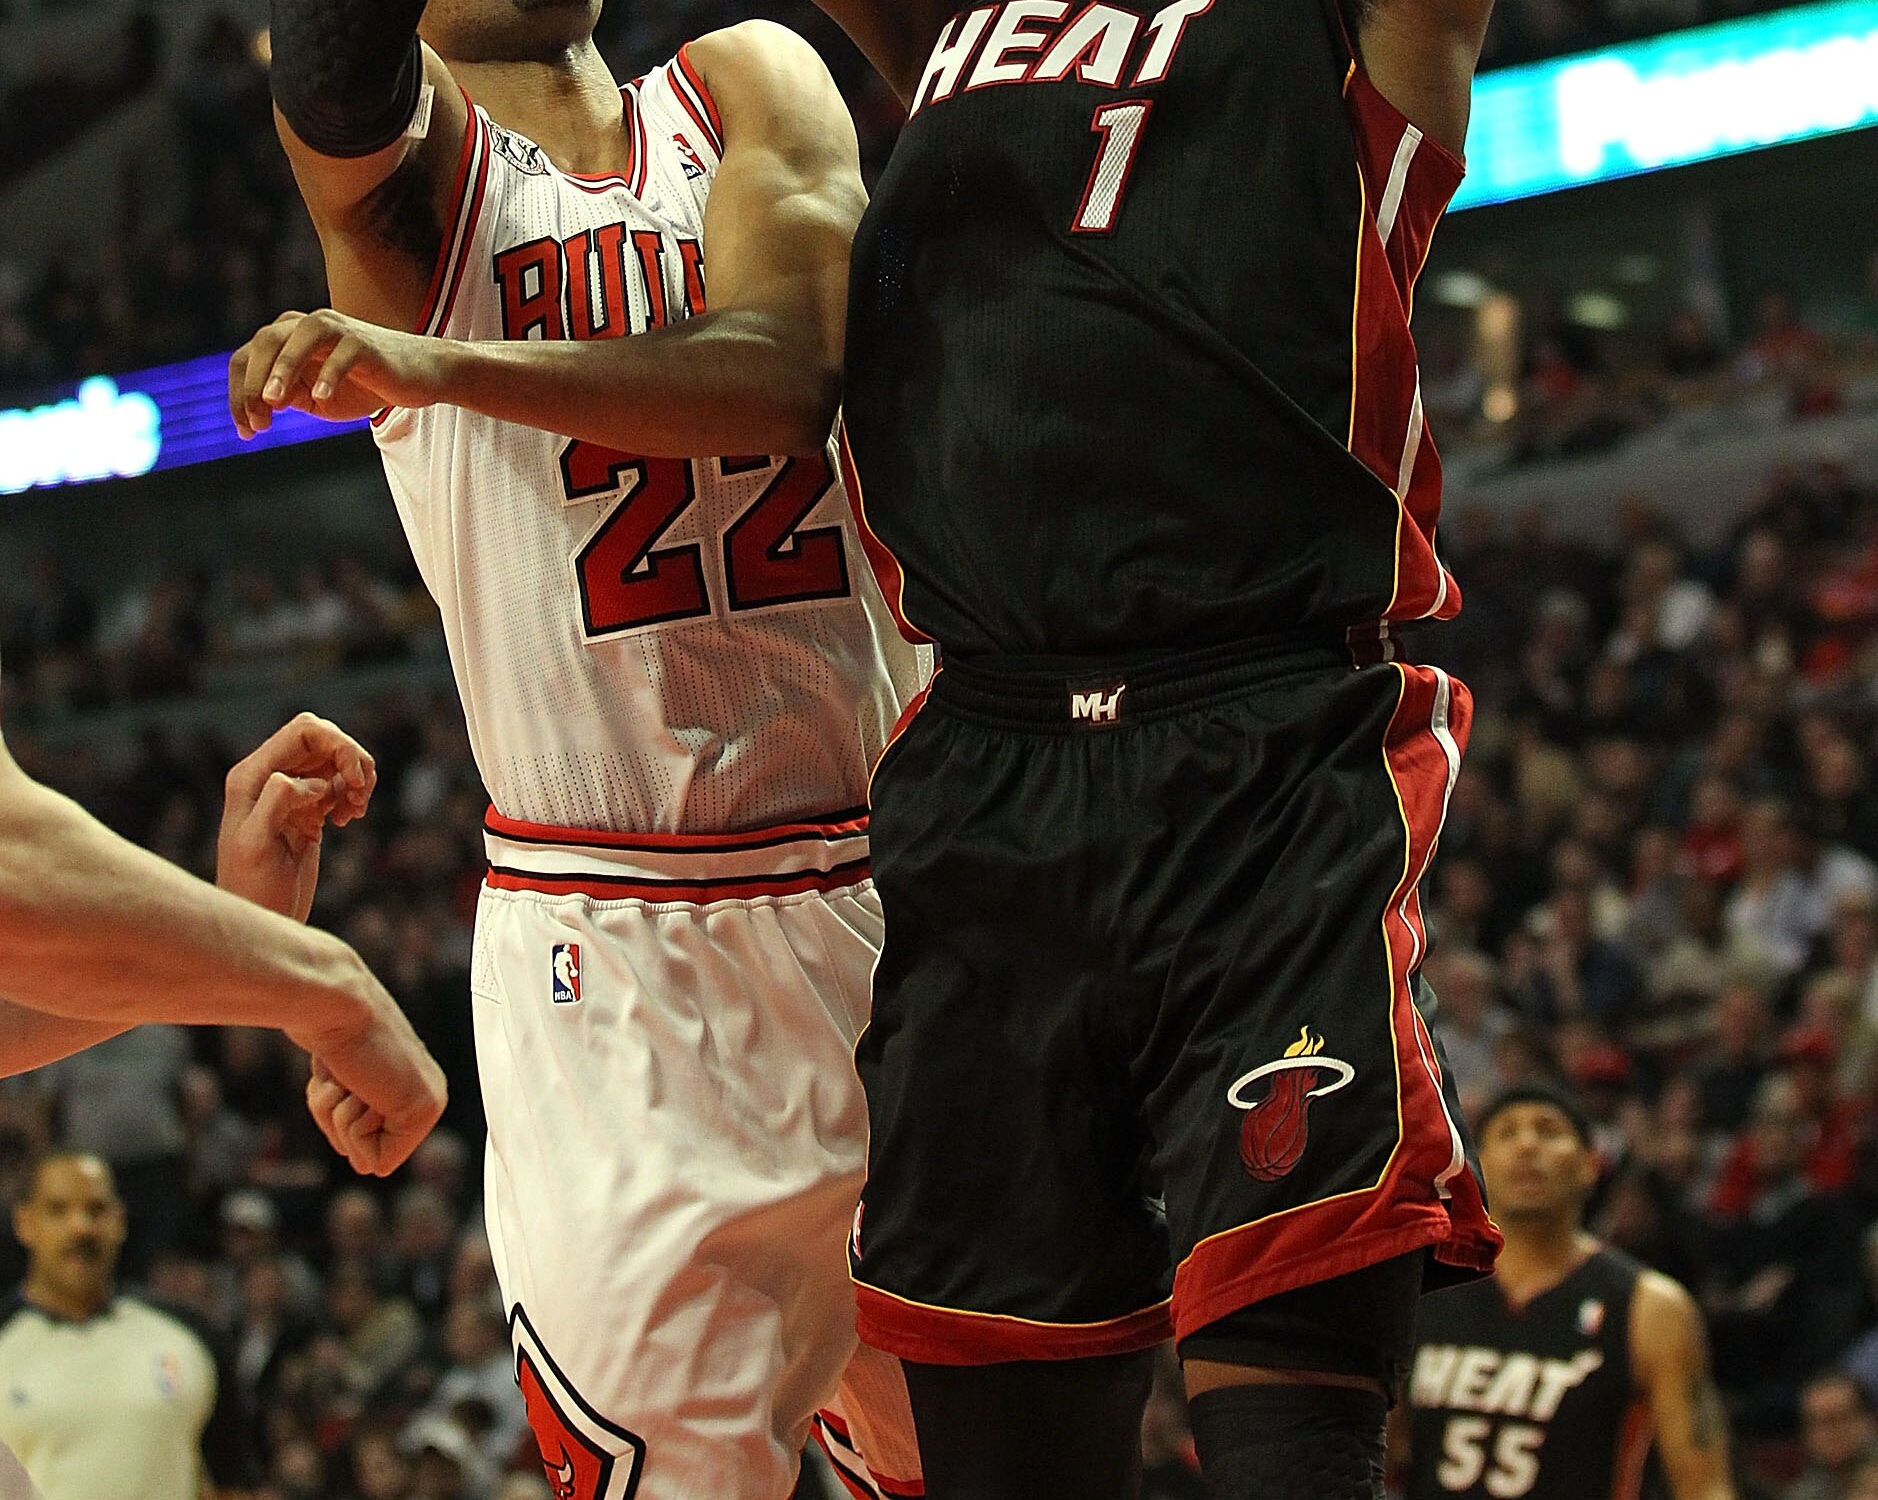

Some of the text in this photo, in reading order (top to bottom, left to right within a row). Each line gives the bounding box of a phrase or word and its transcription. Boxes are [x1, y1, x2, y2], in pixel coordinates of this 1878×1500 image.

[1071, 99, 1154, 234] 1
[493, 220, 706, 340] BULL
[558, 436, 852, 641] 22
[1072, 684, 1126, 722] MH
[554, 990, 572, 1001] NBA
[1409, 1343, 1604, 1422] HEAT
[1436, 1415, 1546, 1500] 55
